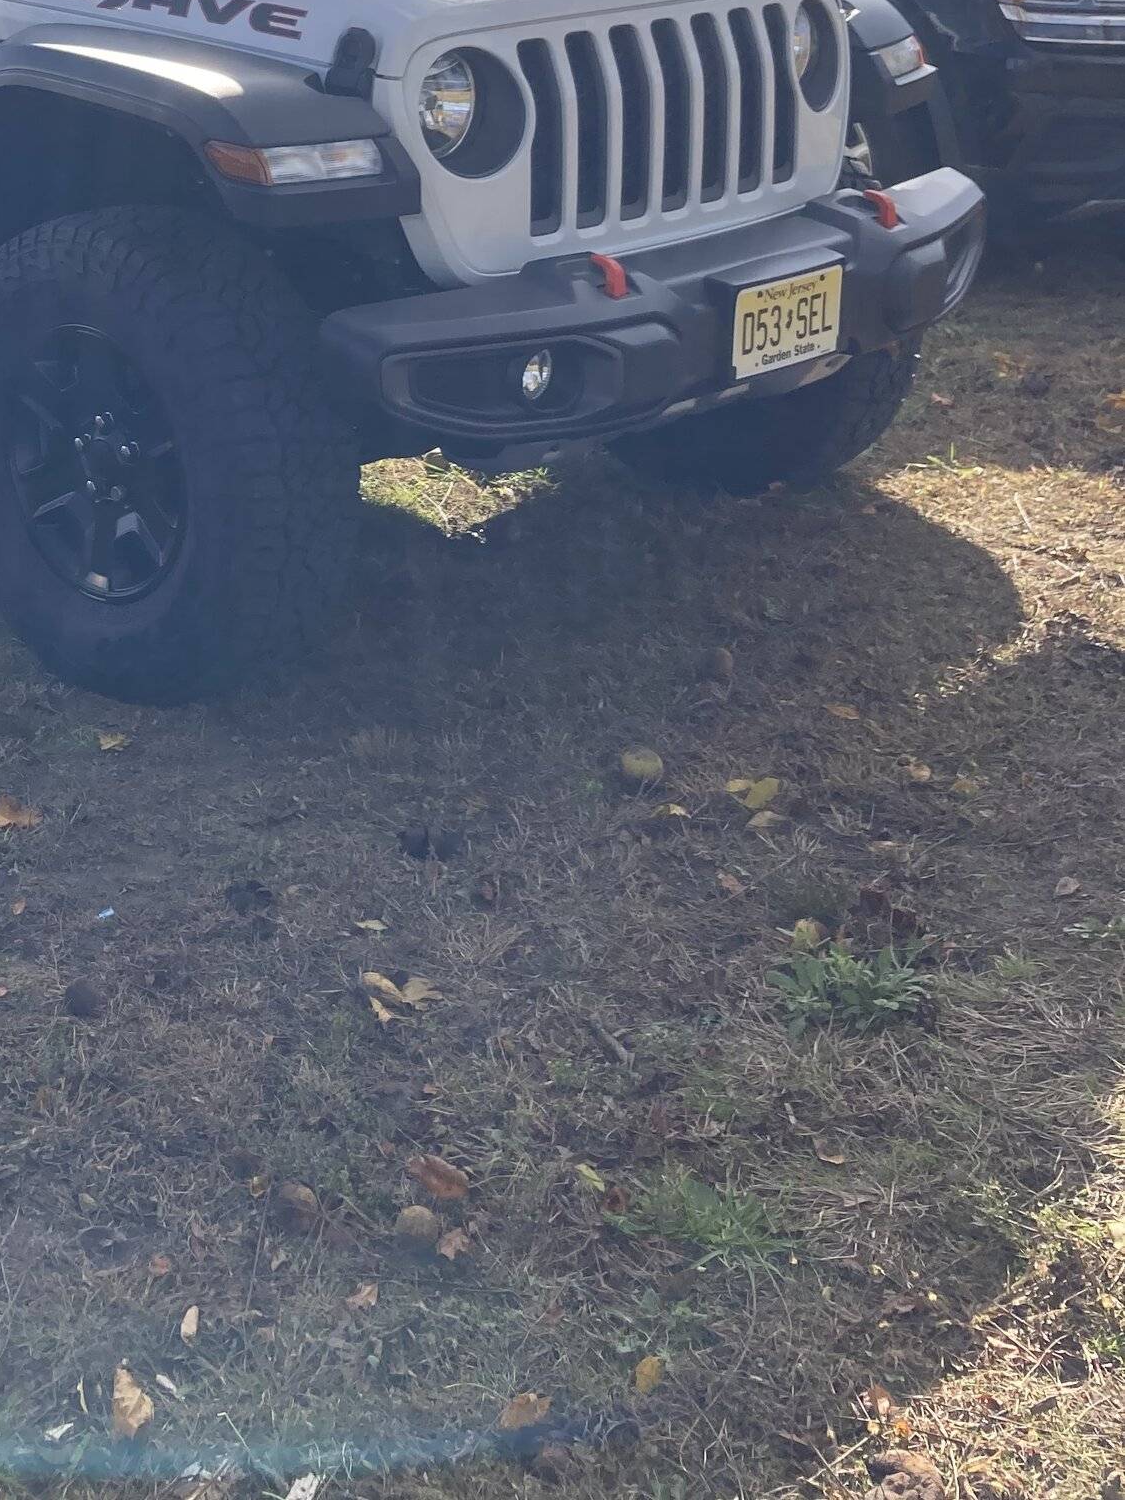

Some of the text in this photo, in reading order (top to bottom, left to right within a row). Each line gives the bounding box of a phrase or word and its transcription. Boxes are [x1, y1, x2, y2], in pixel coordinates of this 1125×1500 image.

[765, 282, 816, 301] New Jersey
[762, 342, 815, 365] Garden State
